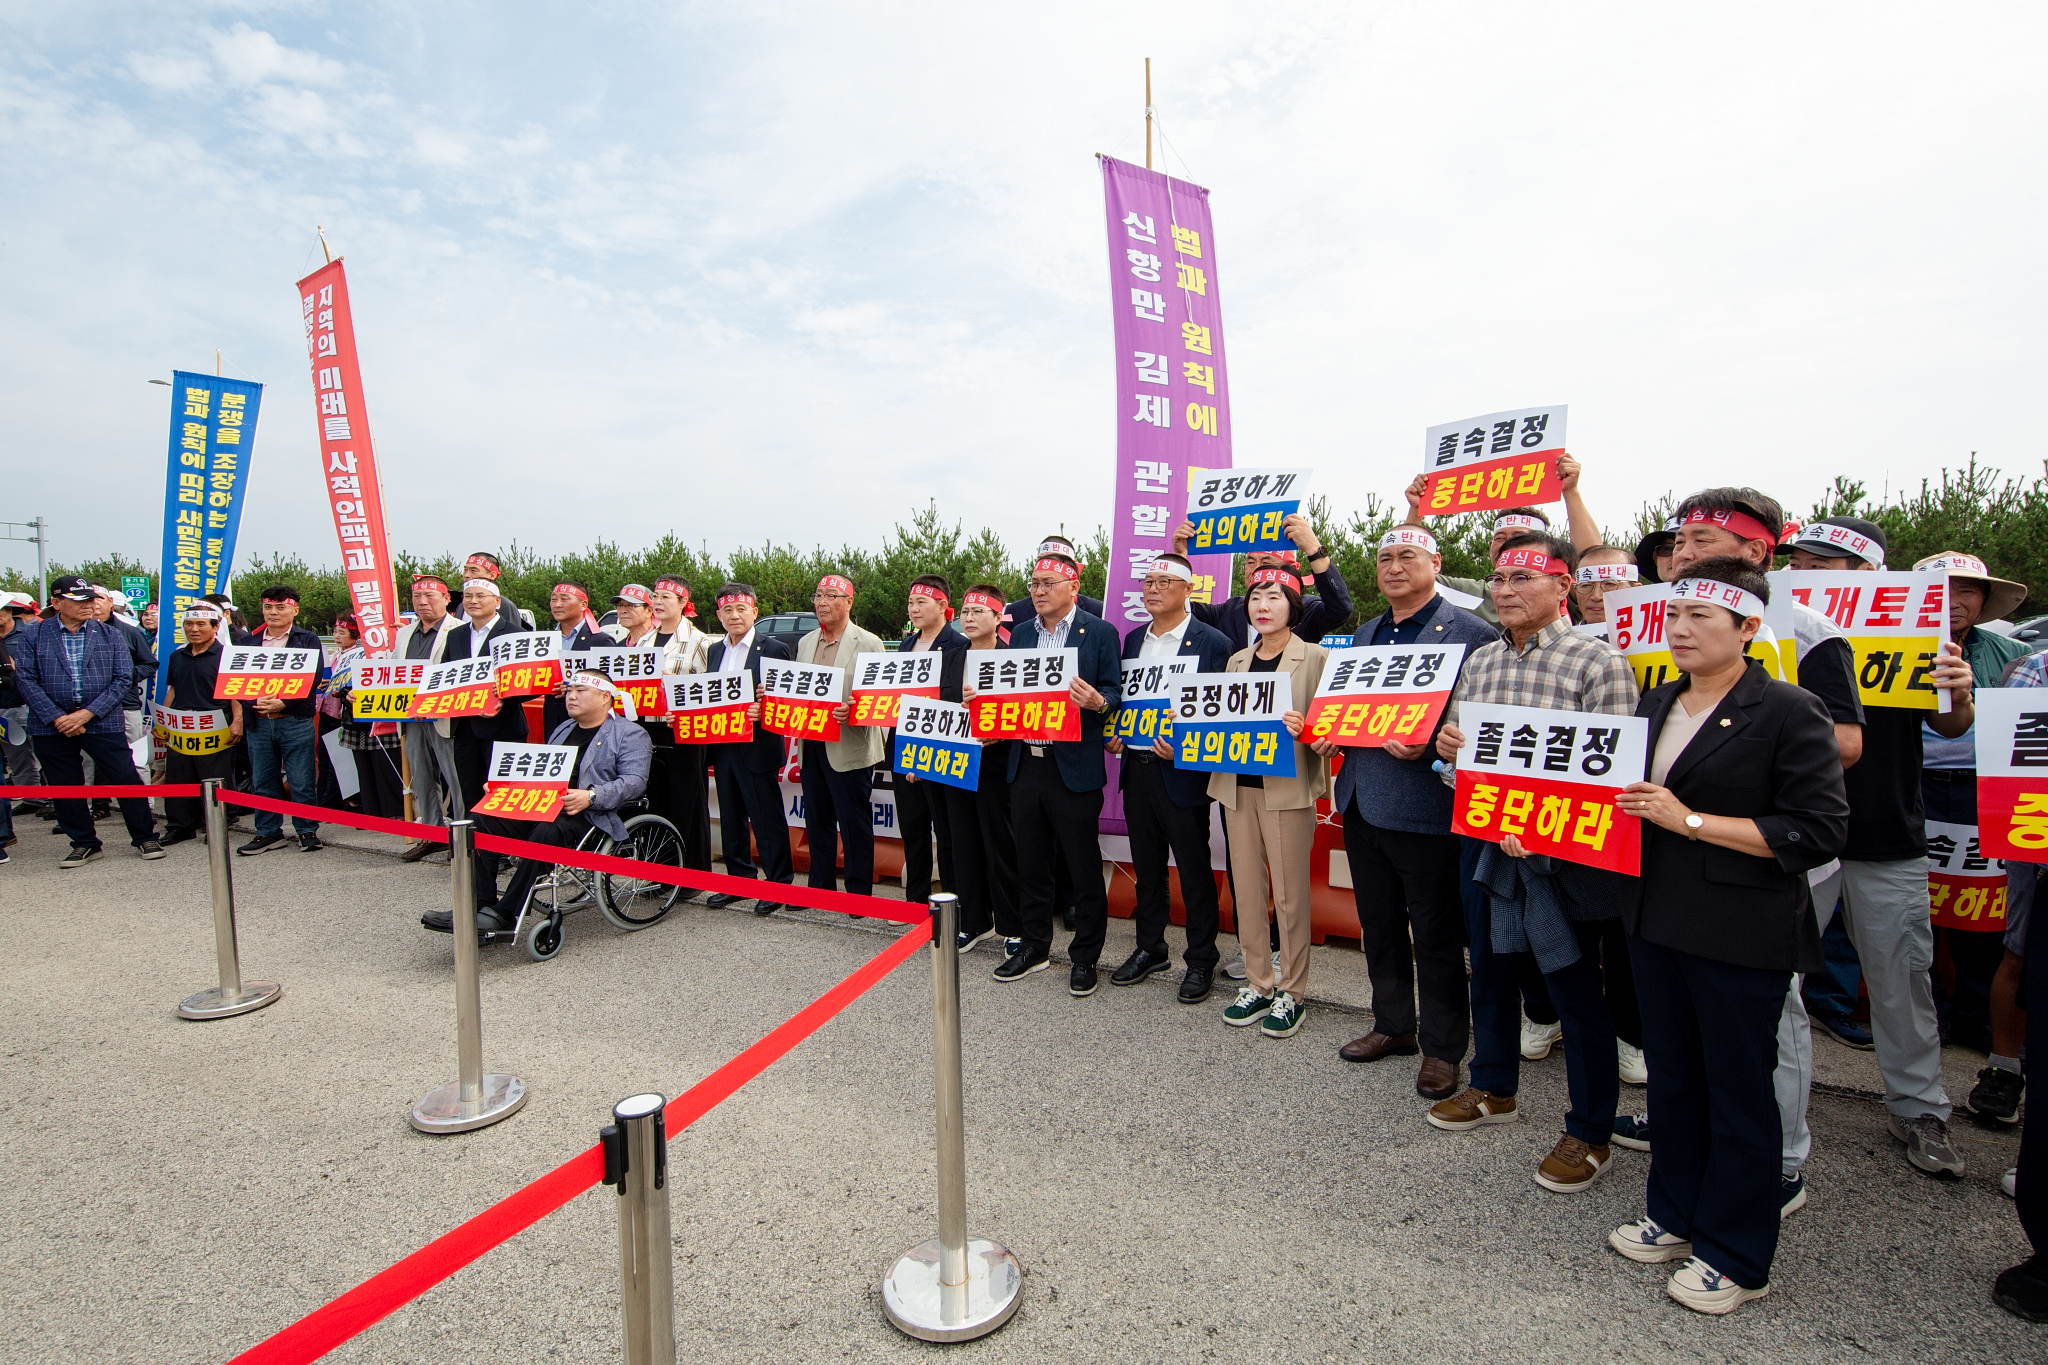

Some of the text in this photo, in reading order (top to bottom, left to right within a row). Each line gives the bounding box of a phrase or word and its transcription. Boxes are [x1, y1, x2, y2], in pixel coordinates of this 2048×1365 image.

[1122, 211, 1166, 323] 신항만
[318, 284, 338, 358] 지역의
[1133, 351, 1171, 428] 김제
[1181, 321, 1218, 436] 원칙에
[184, 387, 210, 419] 법과
[215, 392, 246, 444] 분쟁을
[319, 366, 352, 441] 미래를
[181, 422, 208, 469] 원칙에
[1436, 414, 1550, 466] 졸속결정
[178, 473, 204, 506] 따라
[209, 453, 238, 528] 조장하는
[1197, 473, 1298, 507] 공정하게
[1430, 461, 1546, 509] 중단하라
[329, 450, 376, 571] 사적인맥과
[1195, 511, 1284, 548] 심의하라
[174, 510, 203, 590] 새만금신항
[229, 652, 308, 671] 졸속결정
[360, 665, 424, 687] 공개토론
[427, 660, 491, 690] 졸속결정
[861, 658, 933, 686] 졸속결정
[978, 655, 1065, 691] 졸속결정
[1328, 652, 1446, 692] 졸속결정
[1859, 650, 1938, 694] 하라
[223, 677, 304, 696] 중단하라
[495, 667, 553, 694] 단하라
[673, 675, 742, 707] 졸속결정
[764, 668, 833, 697] 졸속결정
[360, 693, 416, 714] 실시하
[416, 689, 489, 714] 중단하라
[978, 701, 1067, 731] 중단하라
[1180, 680, 1276, 719] 공정하게
[155, 709, 214, 730] 공개토론
[678, 711, 746, 739] 중단하라
[764, 702, 829, 734] 중단하라
[904, 706, 970, 739] 공정하게
[1311, 703, 1430, 737] 중단하라
[497, 752, 568, 777] 졸속결정
[901, 743, 969, 779] 심의하라
[1181, 731, 1278, 765] 심의하라
[1473, 722, 1622, 776] 졸속결정
[483, 787, 559, 814] 중단하라
[1465, 783, 1614, 852] 중단하라
